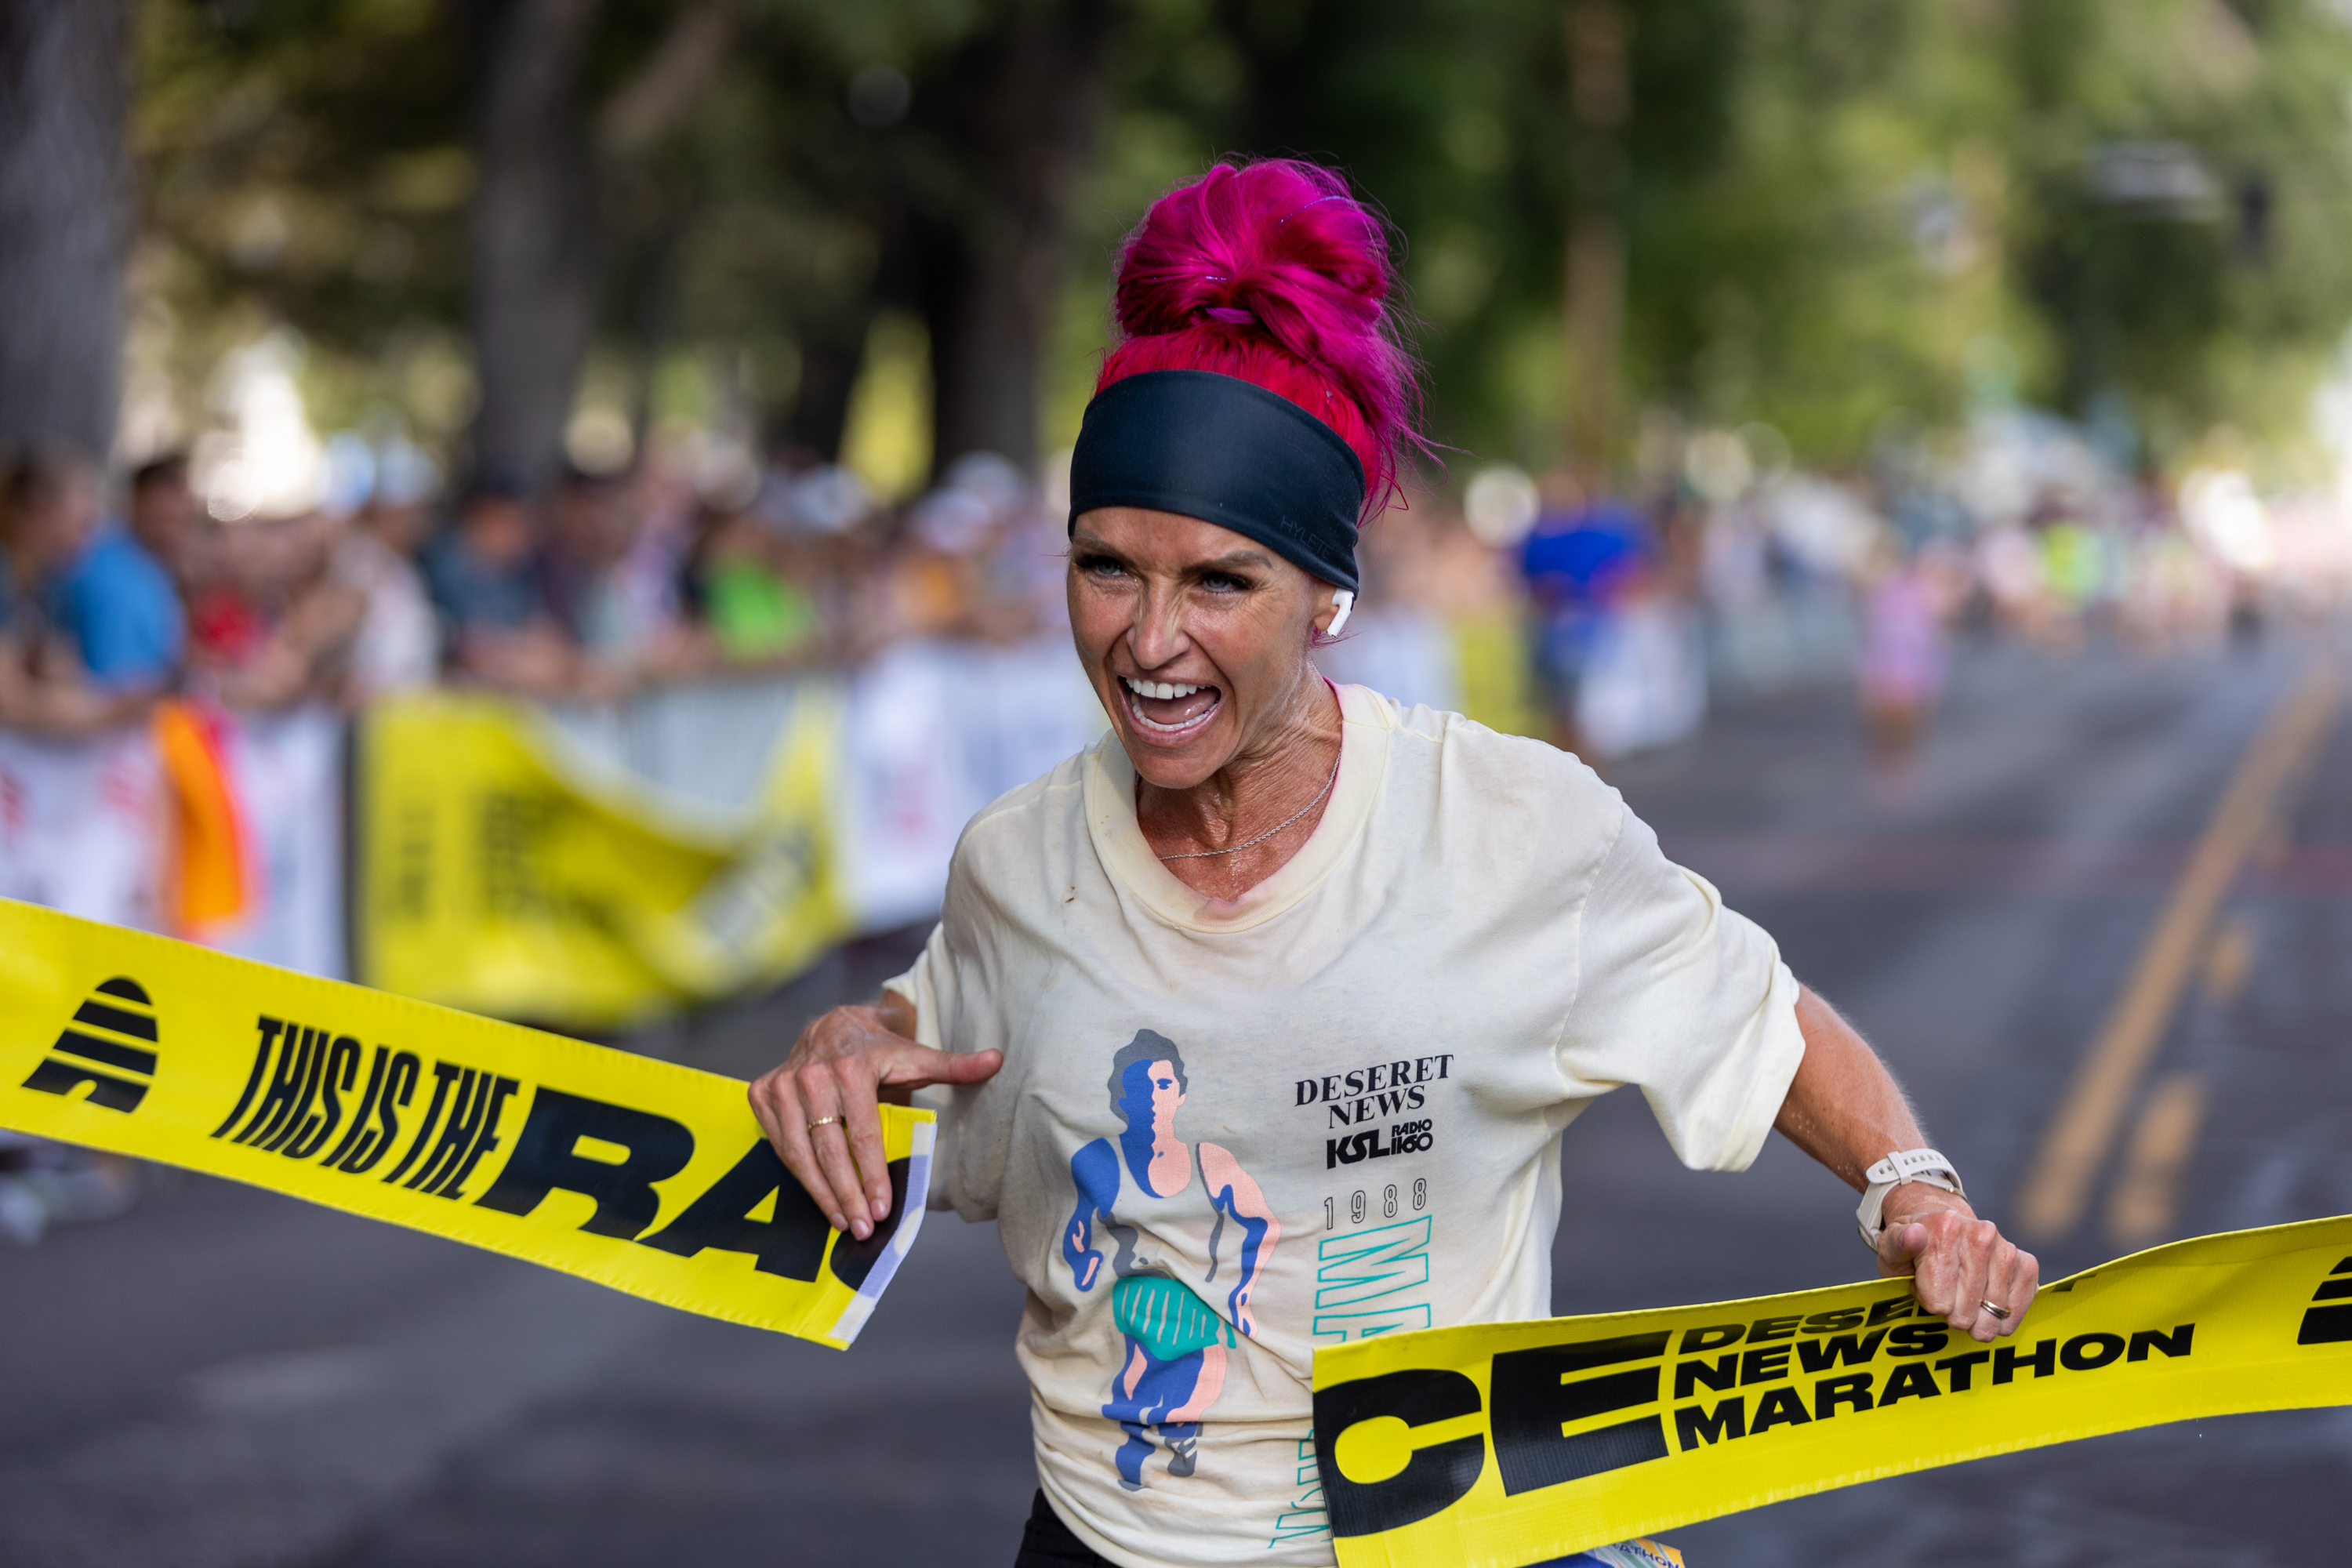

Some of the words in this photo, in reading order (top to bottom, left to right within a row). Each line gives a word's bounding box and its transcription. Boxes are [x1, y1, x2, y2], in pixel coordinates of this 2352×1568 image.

[1280, 515, 1334, 561] HYLETE
[1294, 1054, 1454, 1106] DESERET
[209, 1013, 361, 1160] THIS
[319, 1044, 420, 1174] IS
[380, 1058, 521, 1201] THE
[1328, 1084, 1425, 1129] NEWS
[1392, 1119, 1432, 1137] RADIO
[1327, 1129, 1390, 1169] KSL
[1391, 1132, 1433, 1155] 1160
[1324, 1178, 1426, 1229] 1988
[1678, 1294, 1949, 1355] DESE
[1674, 1322, 1949, 1399] NEWS
[1674, 1323, 2195, 1453] MARATHON
[1313, 1330, 1670, 1537] CE
